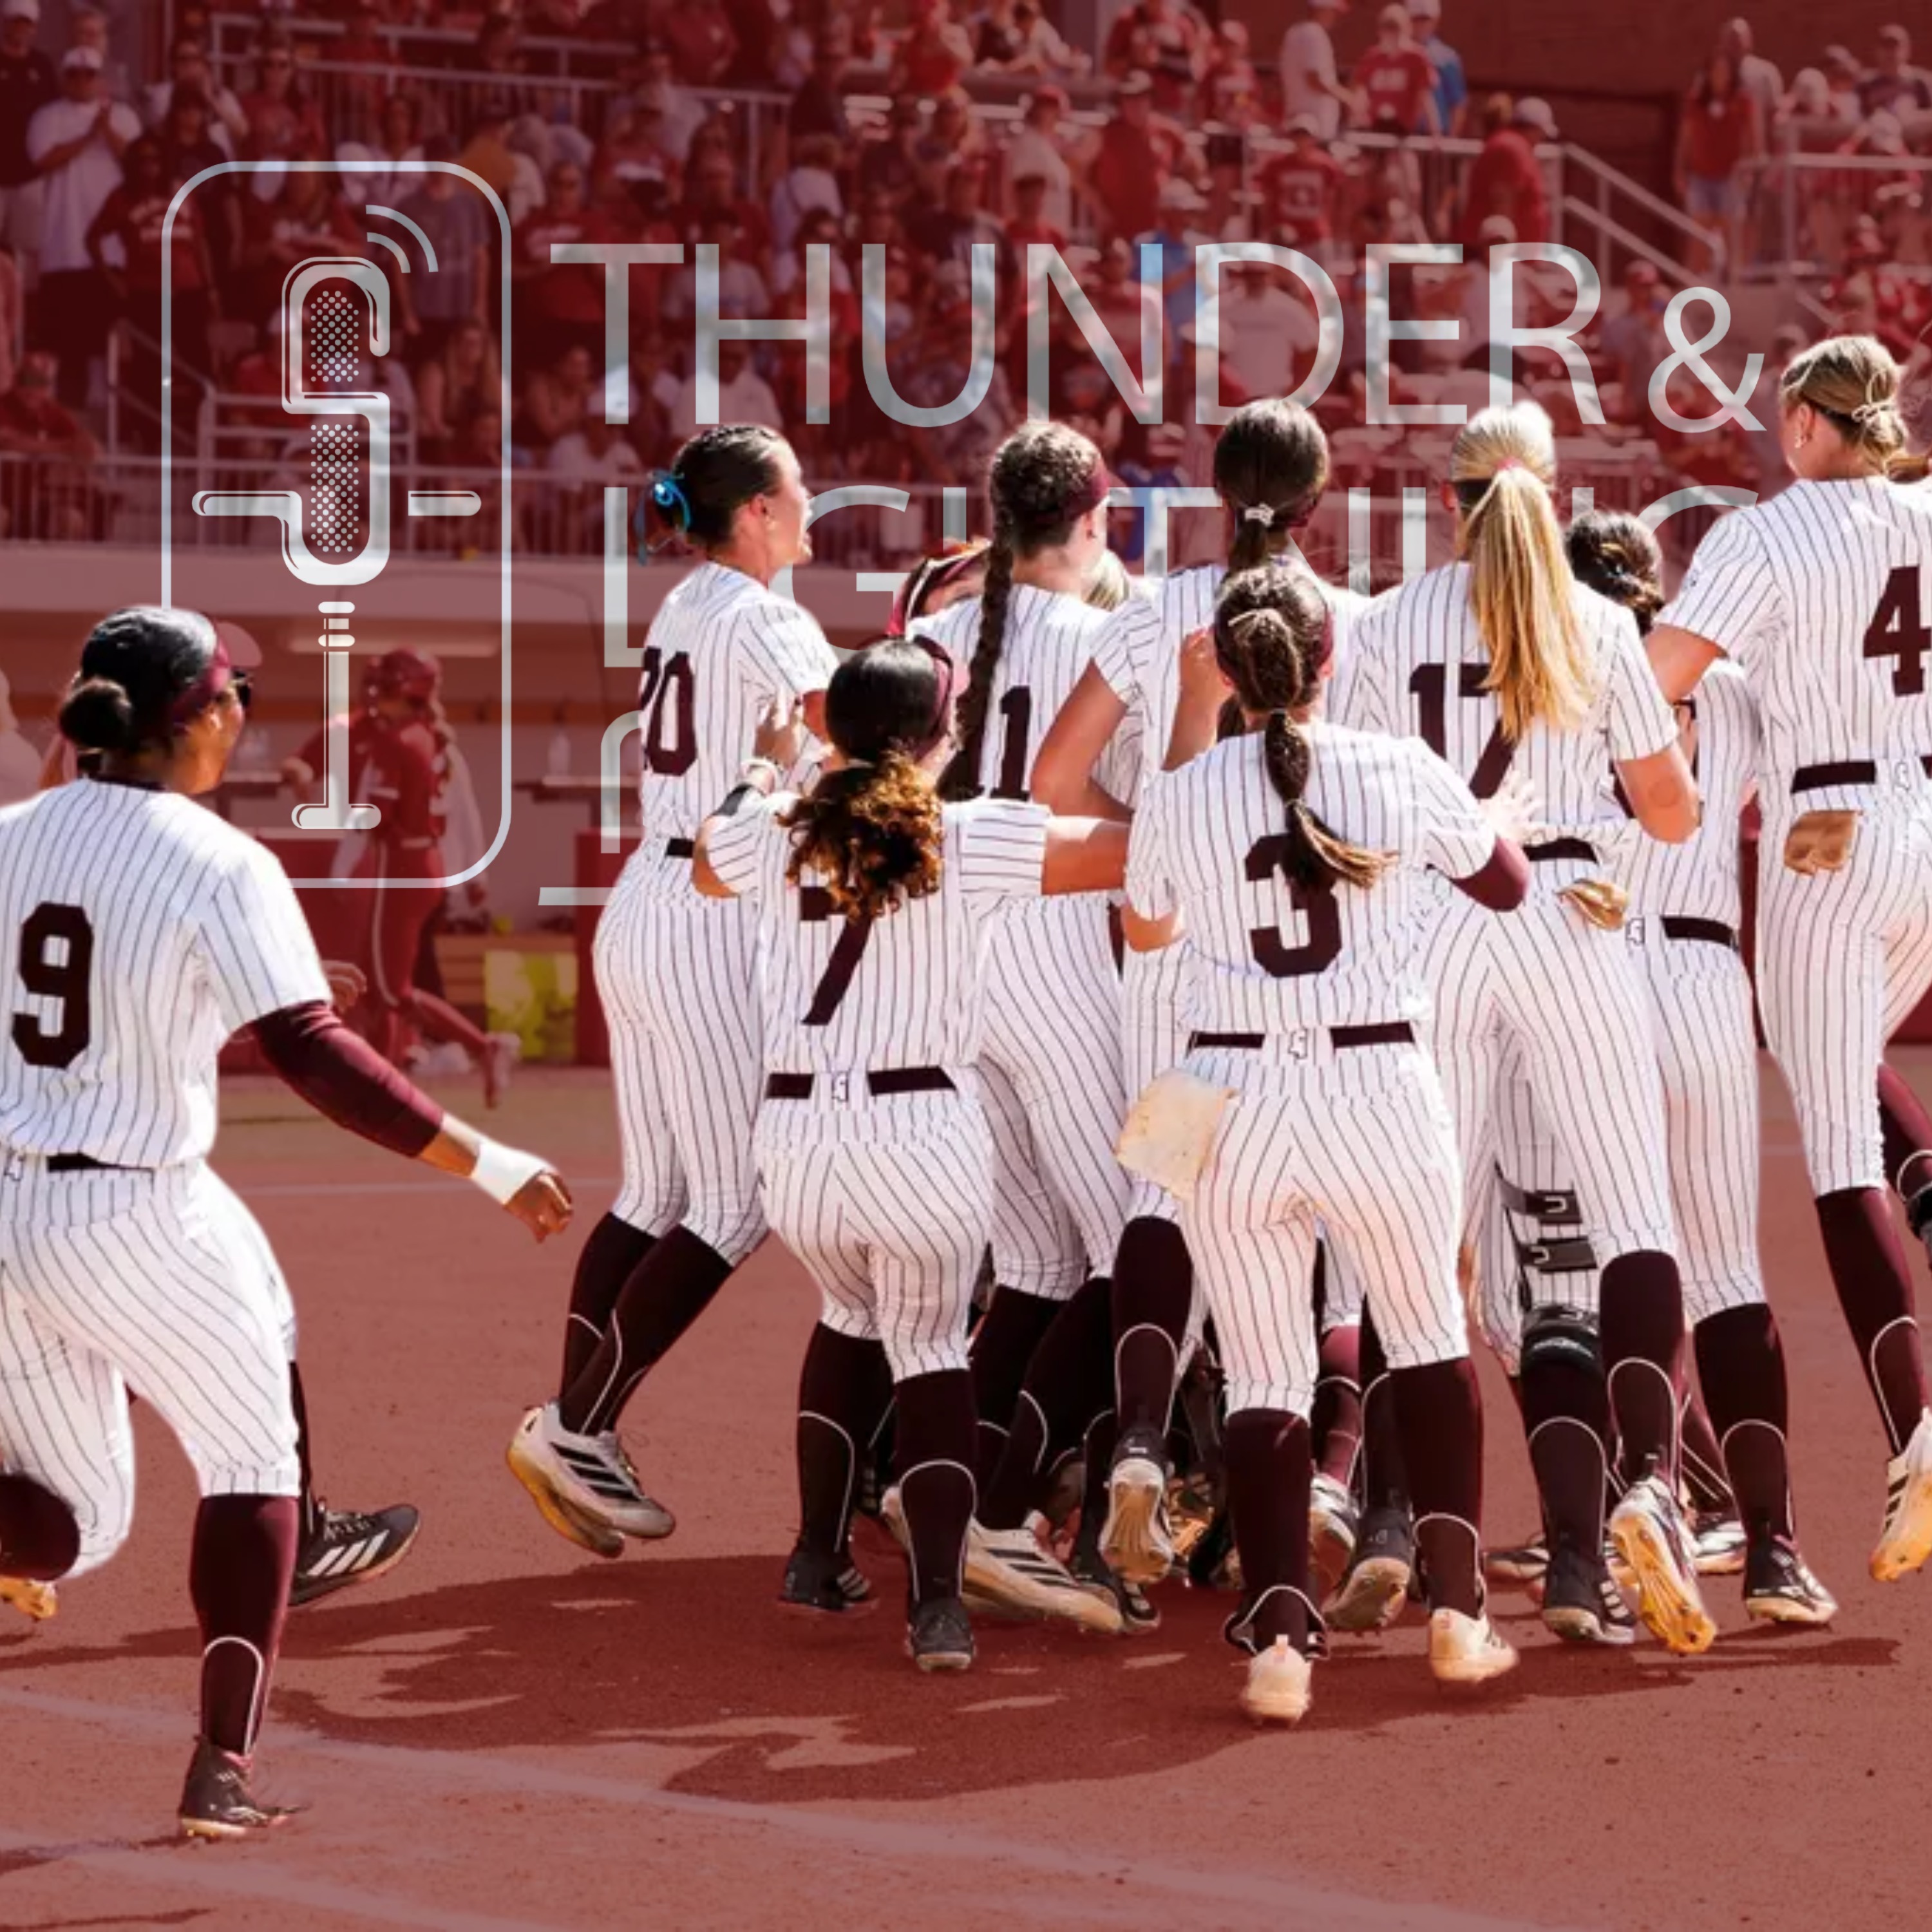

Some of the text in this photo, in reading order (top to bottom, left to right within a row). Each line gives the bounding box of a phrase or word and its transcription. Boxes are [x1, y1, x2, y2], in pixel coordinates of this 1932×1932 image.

[1863, 565, 1931, 697] 4
[1409, 663, 1519, 800] 17
[800, 887, 876, 1025] 7
[1245, 832, 1343, 978] 3
[12, 902, 94, 1068] 9
